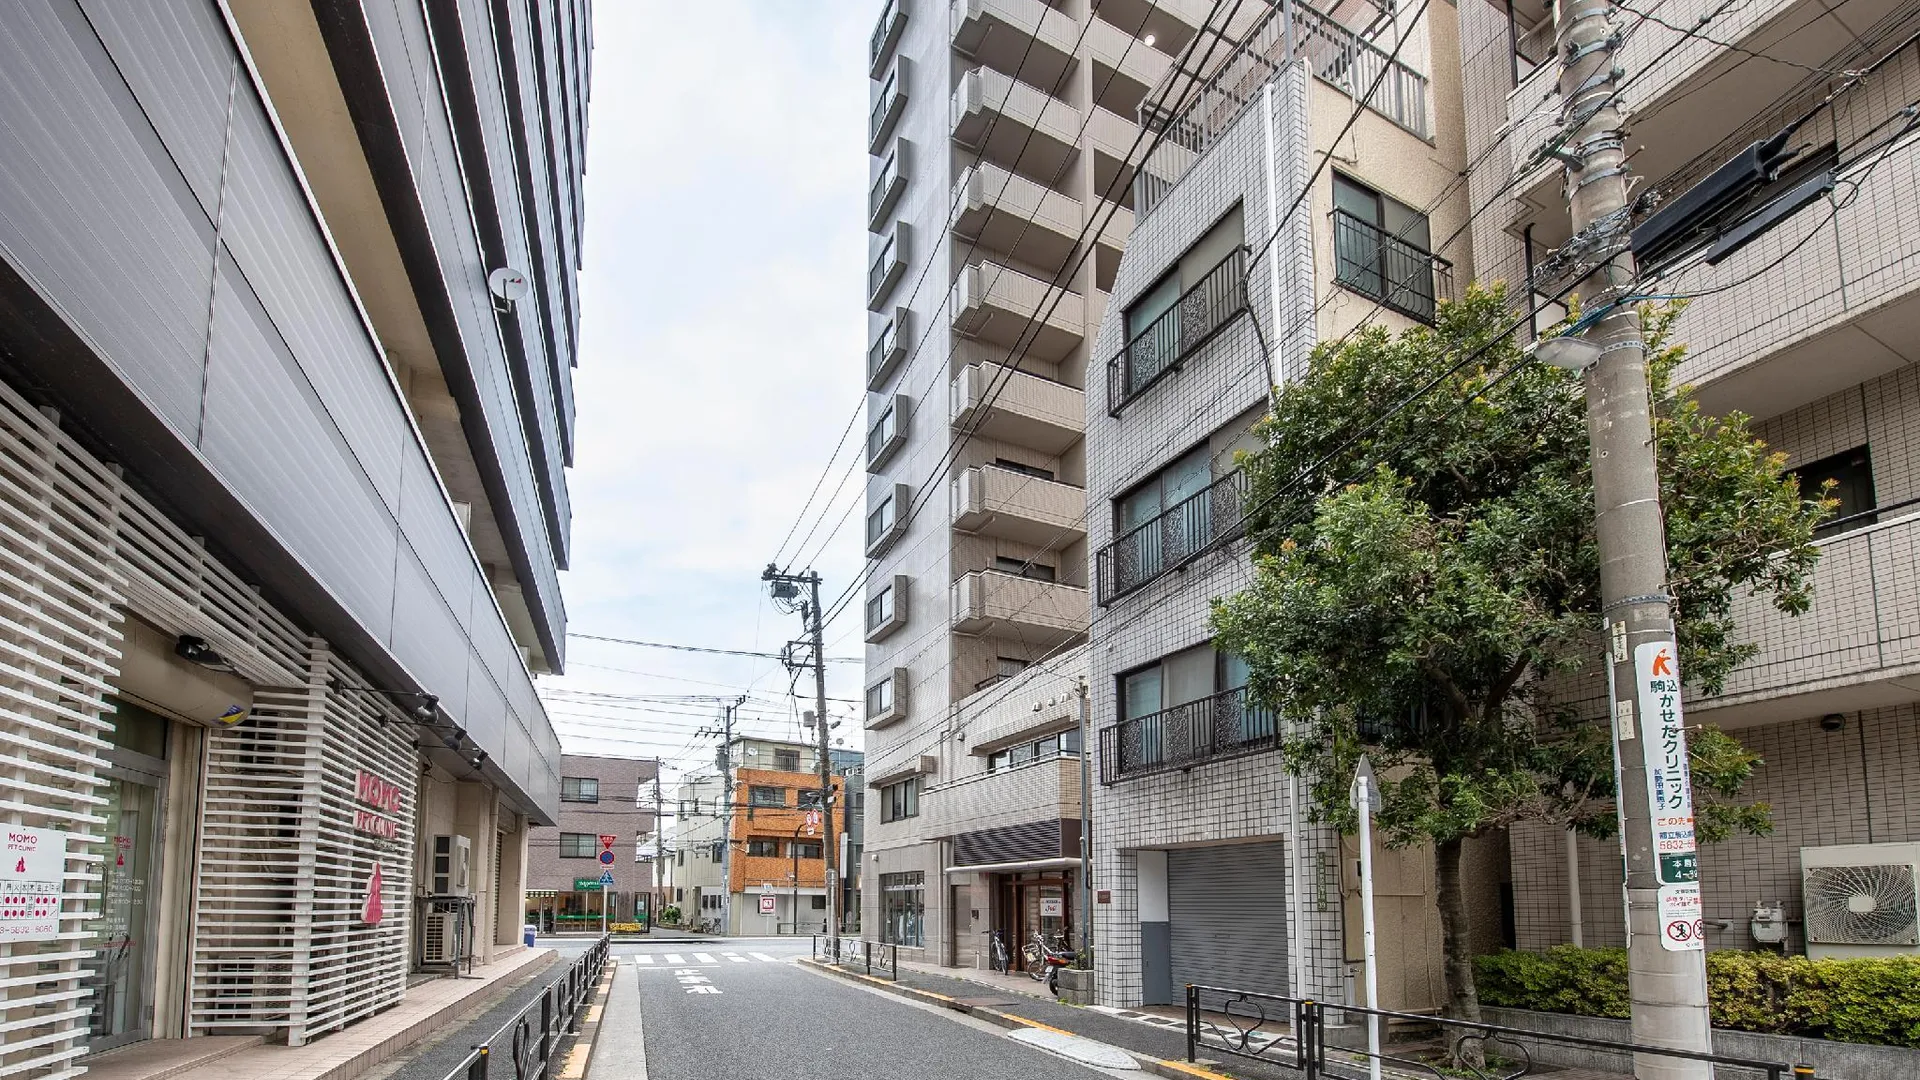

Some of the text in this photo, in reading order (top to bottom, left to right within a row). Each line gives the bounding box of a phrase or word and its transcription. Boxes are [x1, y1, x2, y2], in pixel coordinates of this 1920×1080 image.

[1650, 680, 1678, 693] 駒込
[1658, 693, 1682, 809] かせだクリニック
[356, 769, 401, 813] MOMO
[353, 810, 372, 832] PET
[1657, 817, 1685, 826] この先
[8, 832, 38, 844] MOMO
